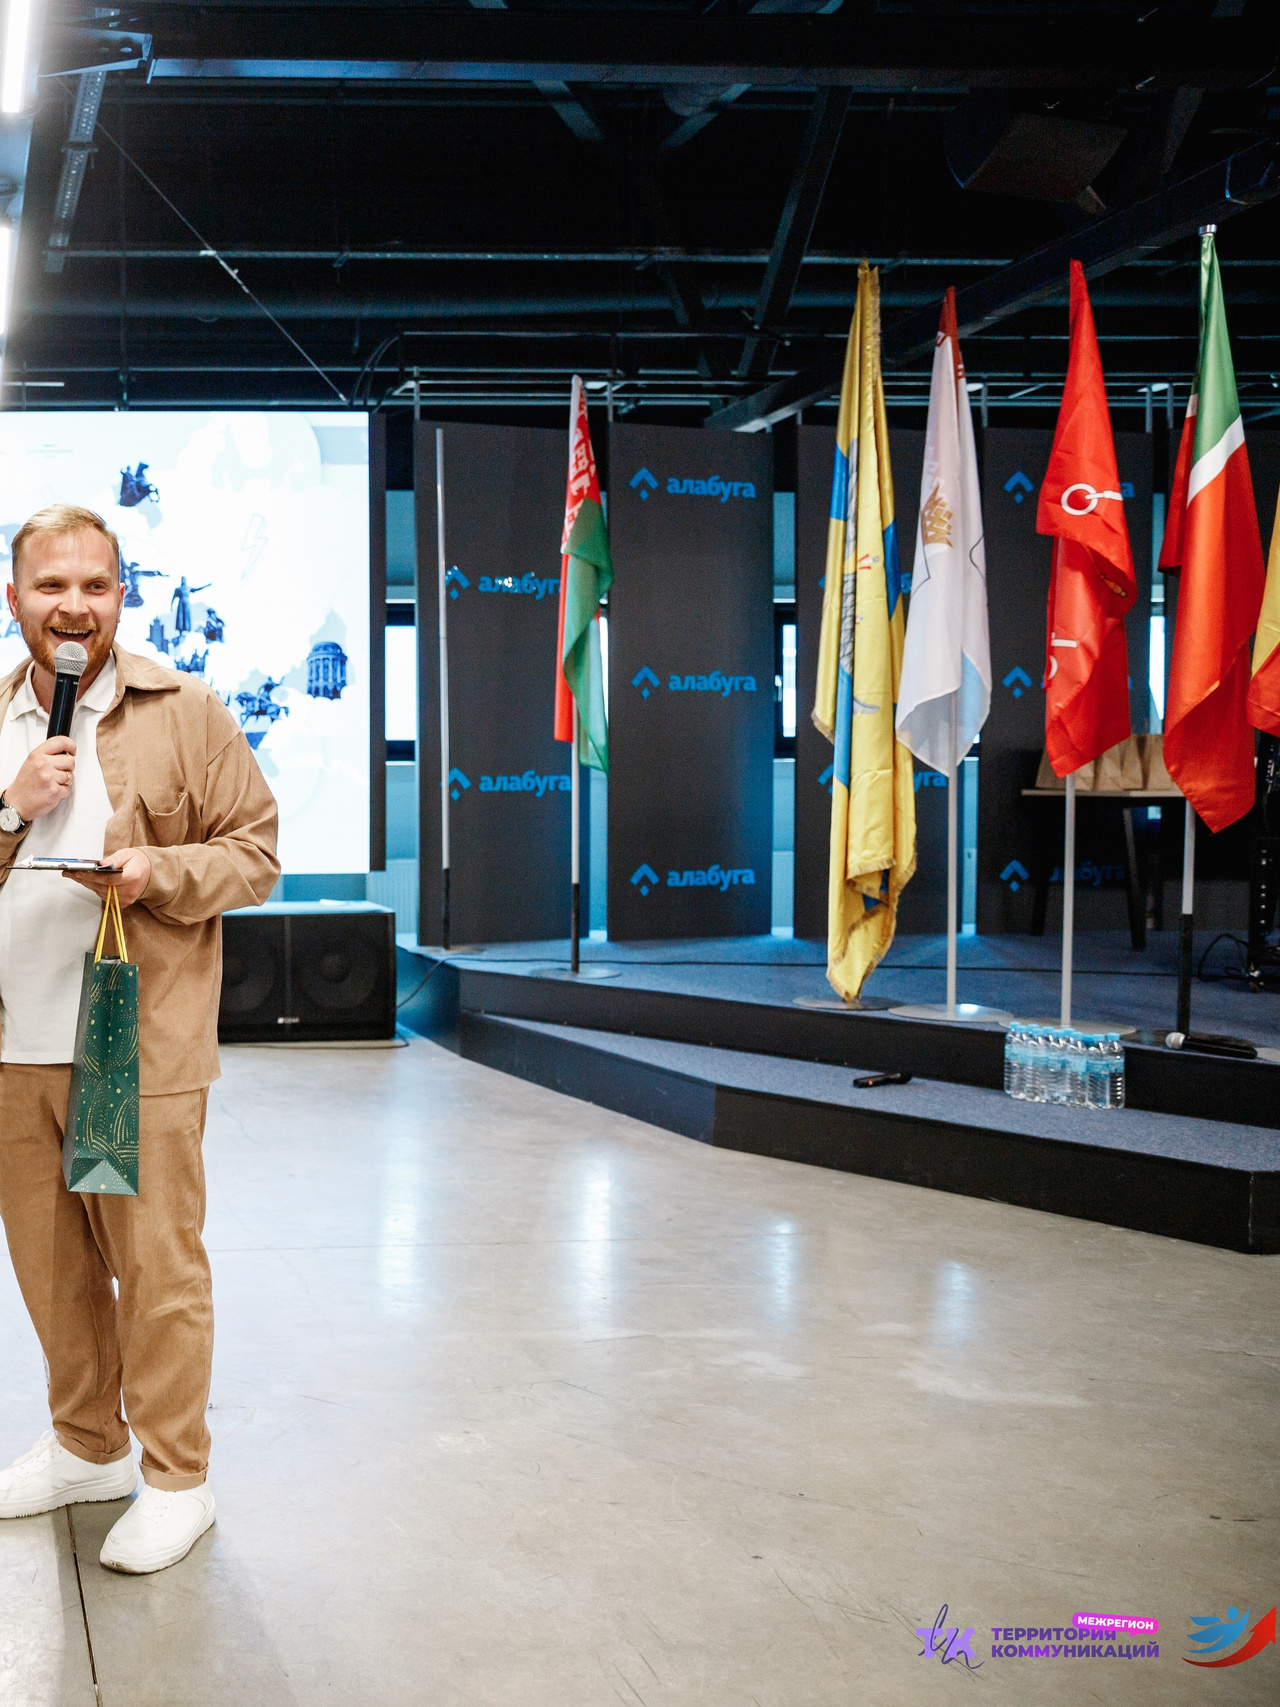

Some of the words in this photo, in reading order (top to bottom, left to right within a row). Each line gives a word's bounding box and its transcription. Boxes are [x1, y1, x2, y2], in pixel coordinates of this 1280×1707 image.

[667, 475, 756, 502] алабуга
[478, 572, 561, 601] алабуг
[668, 670, 757, 698] алабуга
[479, 769, 571, 798] алабуга
[667, 862, 756, 891] алабуга
